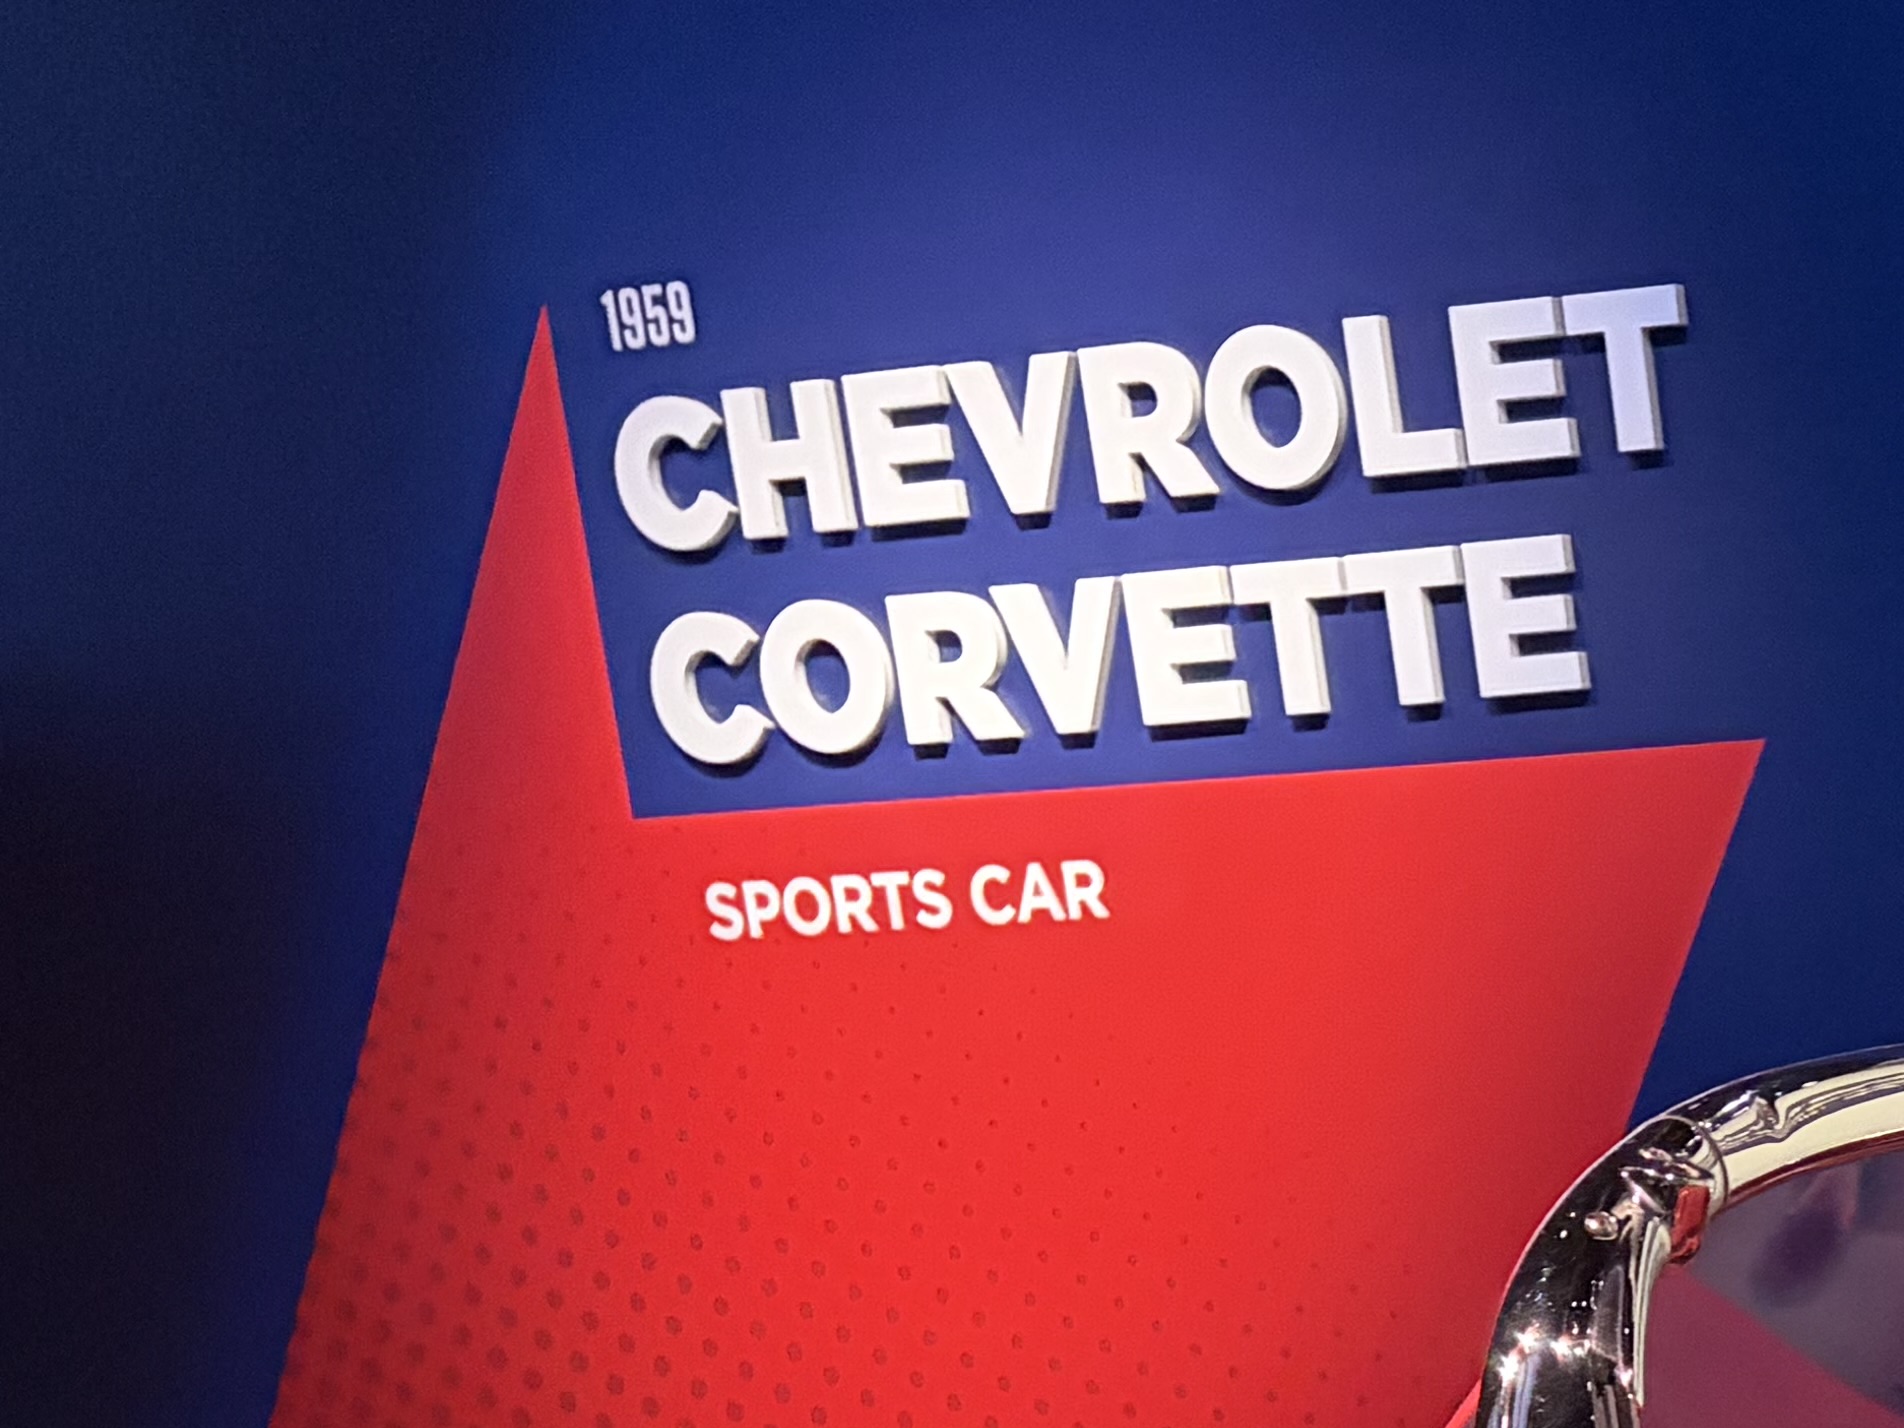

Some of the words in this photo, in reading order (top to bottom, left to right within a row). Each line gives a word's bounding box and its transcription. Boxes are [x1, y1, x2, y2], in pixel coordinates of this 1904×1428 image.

[601, 280, 696, 351] 1959
[613, 283, 1688, 554] CHEVROLET
[649, 533, 1592, 766] CORVETTE
[704, 868, 953, 942] SPORTS
[970, 859, 1110, 925] CAR
